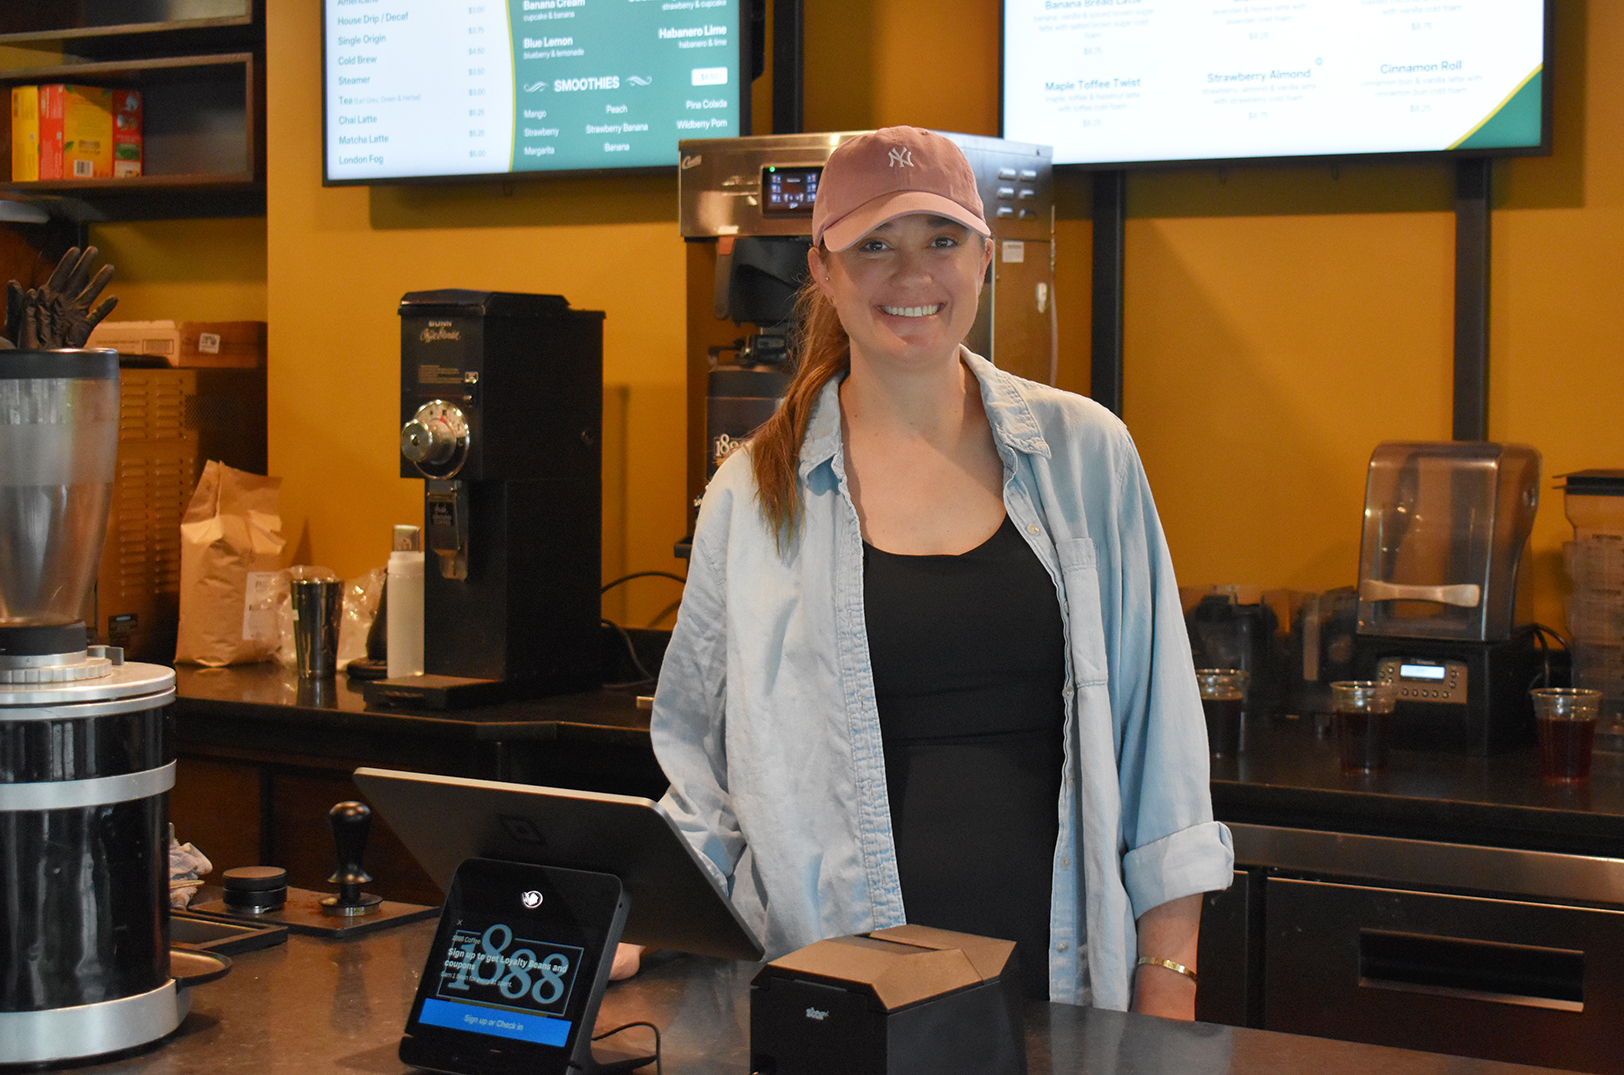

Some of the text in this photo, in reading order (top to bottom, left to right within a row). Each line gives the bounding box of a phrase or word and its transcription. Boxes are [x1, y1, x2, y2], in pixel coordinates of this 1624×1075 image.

[523, 0, 585, 10] Banana Cream
[695, 0, 699, 8] &
[1046, 0, 1081, 9] Banana
[338, 17, 361, 25] House
[364, 14, 379, 24] Drip
[386, 12, 408, 22] Decaf
[524, 12, 547, 22] cupcake
[554, 11, 575, 19] banana
[659, 25, 727, 39] Habanero Lime
[338, 34, 386, 47] Single Origin
[524, 37, 573, 48] Blue Lemon
[678, 38, 727, 48] habanero & lime
[524, 51, 550, 60] blueberry
[556, 48, 584, 57] lemonade
[338, 55, 377, 65] Cold Brew
[1380, 60, 1462, 74] Cinnamon Roll
[338, 76, 370, 85] Steamer
[1207, 68, 1311, 83] Strawberry Almond
[554, 76, 620, 92] SMOOTHIES
[1045, 78, 1141, 93] Maple Toffee Twist
[339, 96, 353, 105] Tea
[703, 99, 727, 108] Colada
[606, 104, 628, 114] Peach
[524, 110, 547, 119] Mango
[339, 115, 377, 125] Chai Latte
[677, 118, 727, 130] Wildberry Pom
[524, 128, 559, 138] Strawberry
[586, 123, 648, 135] Strawberry Banana
[339, 135, 389, 144] Matcha Latte
[524, 146, 554, 156] Margarita
[604, 143, 630, 152] Banana
[339, 154, 384, 165] London Fog
[888, 146, 914, 168] NY
[465, 936, 481, 944] Coffee
[444, 960, 476, 970] coupons
[448, 948, 568, 974] Sign up to get Loyalty Beans and
[448, 924, 569, 1004] 1888
[464, 1014, 478, 1024] Sign
[479, 1018, 487, 1026] up
[496, 1020, 516, 1030] Check
[517, 1022, 524, 1031] in
